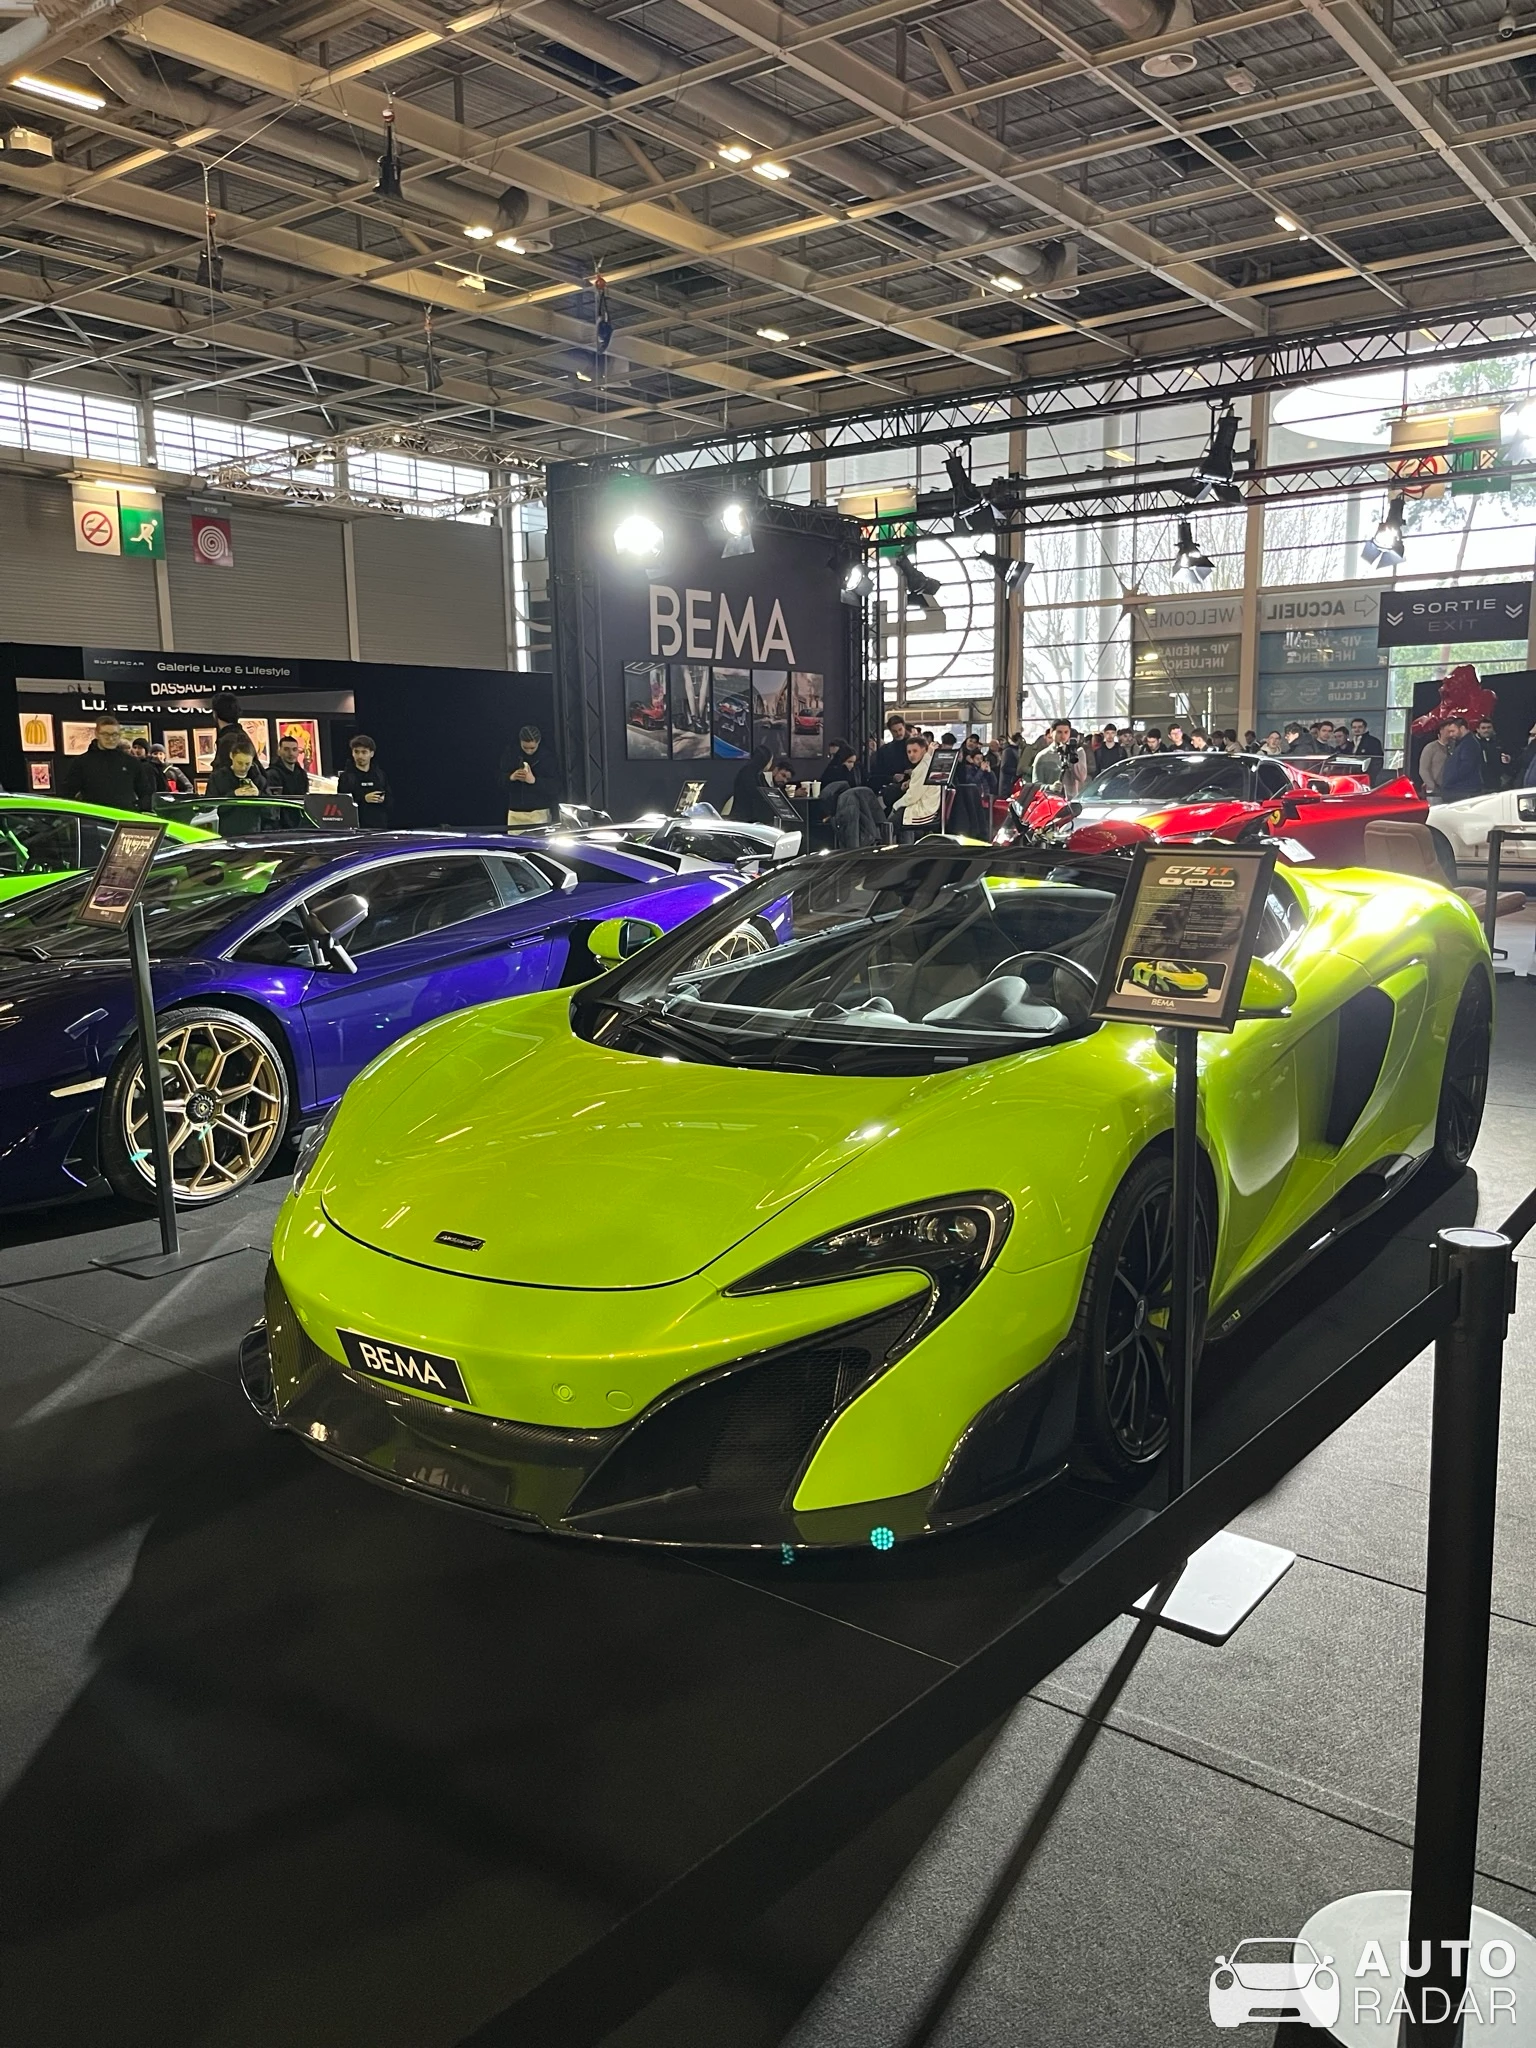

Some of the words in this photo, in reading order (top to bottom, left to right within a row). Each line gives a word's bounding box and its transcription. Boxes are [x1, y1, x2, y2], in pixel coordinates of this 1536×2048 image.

[1412, 598, 1497, 615] SORTIE
[649, 583, 796, 665] BEMA
[1428, 618, 1478, 632] EXIT
[157, 662, 201, 673] Galerie
[203, 664, 232, 674] Luxe
[234, 666, 243, 675] &
[245, 665, 291, 677] Lifestyle
[1164, 865, 1234, 876] 675LT
[1151, 998, 1175, 1008] BEMA
[358, 1341, 447, 1390] BEMA
